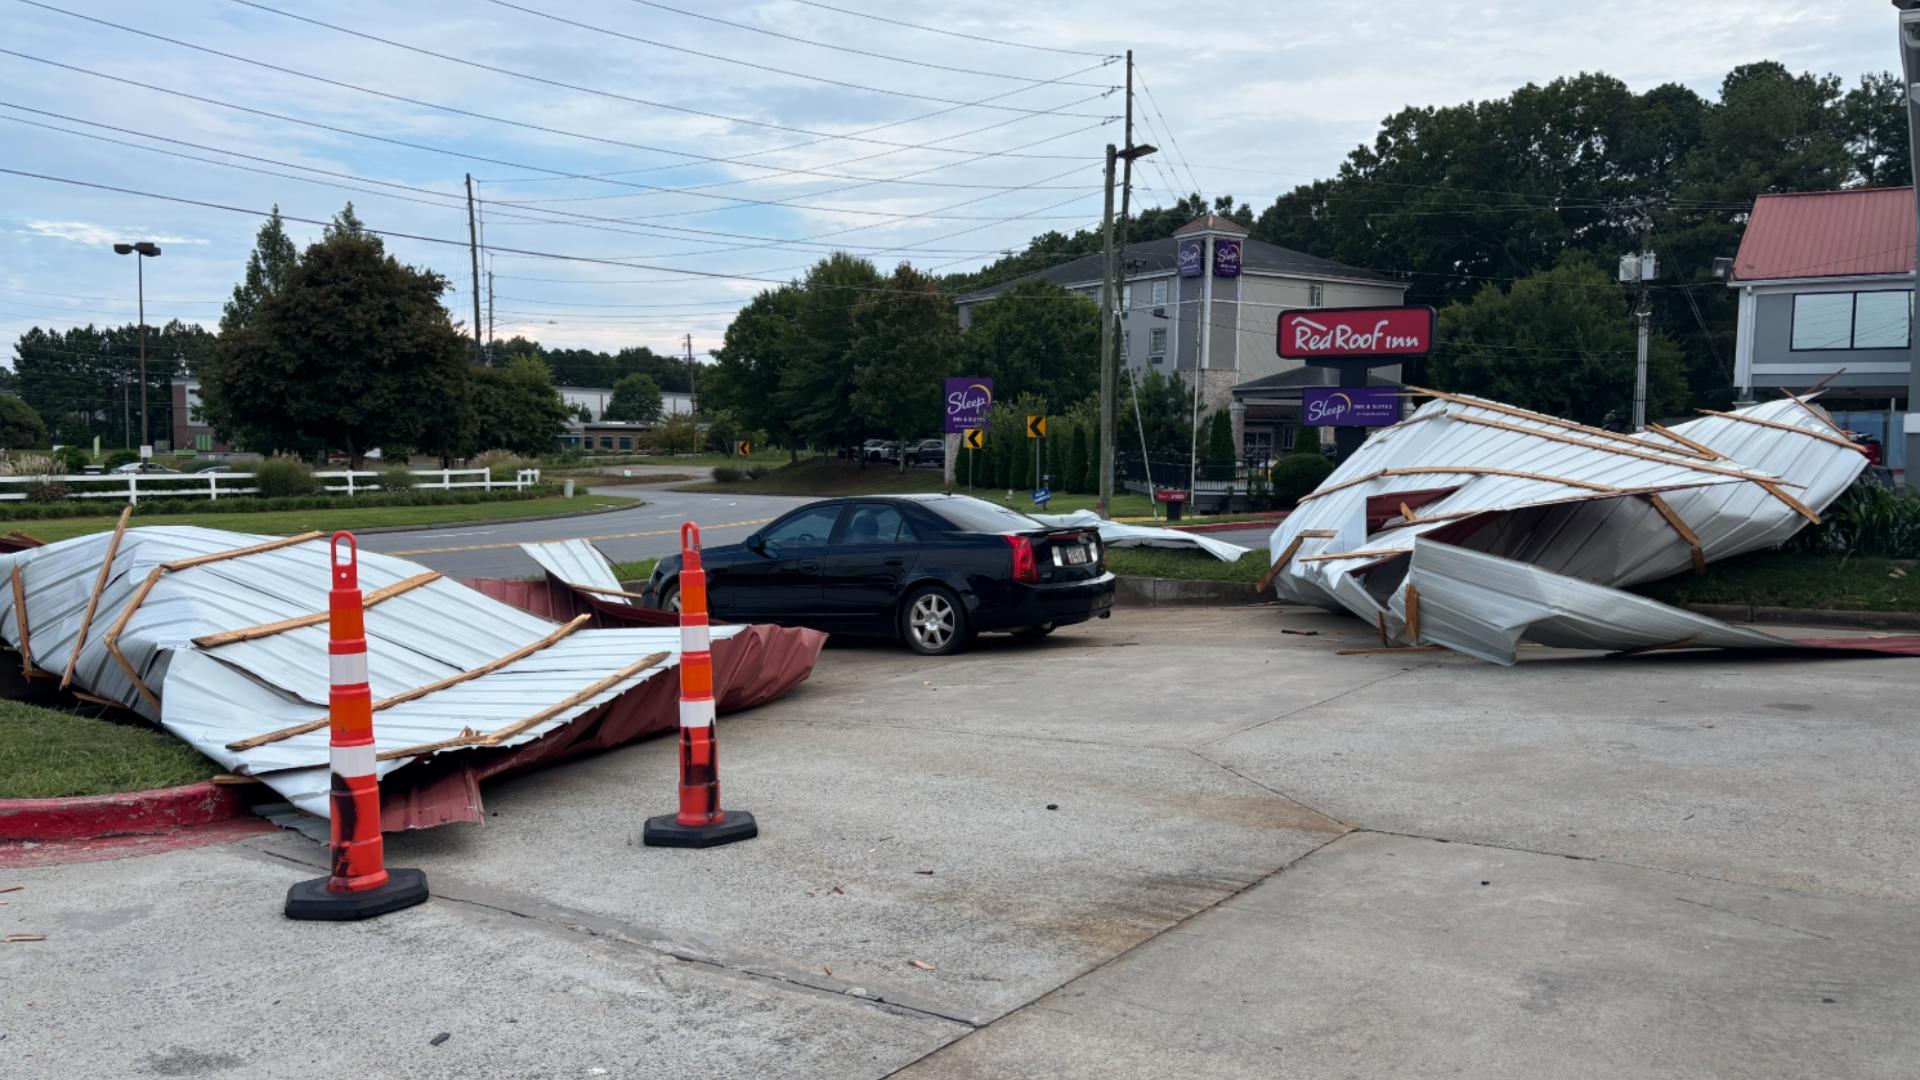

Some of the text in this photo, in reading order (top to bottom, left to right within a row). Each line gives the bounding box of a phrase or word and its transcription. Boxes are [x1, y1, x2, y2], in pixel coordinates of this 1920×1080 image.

[1295, 326, 1334, 351] Red
[1335, 320, 1389, 350] Roof
[947, 391, 987, 415] Sleep
[1308, 399, 1347, 422] Sleep
